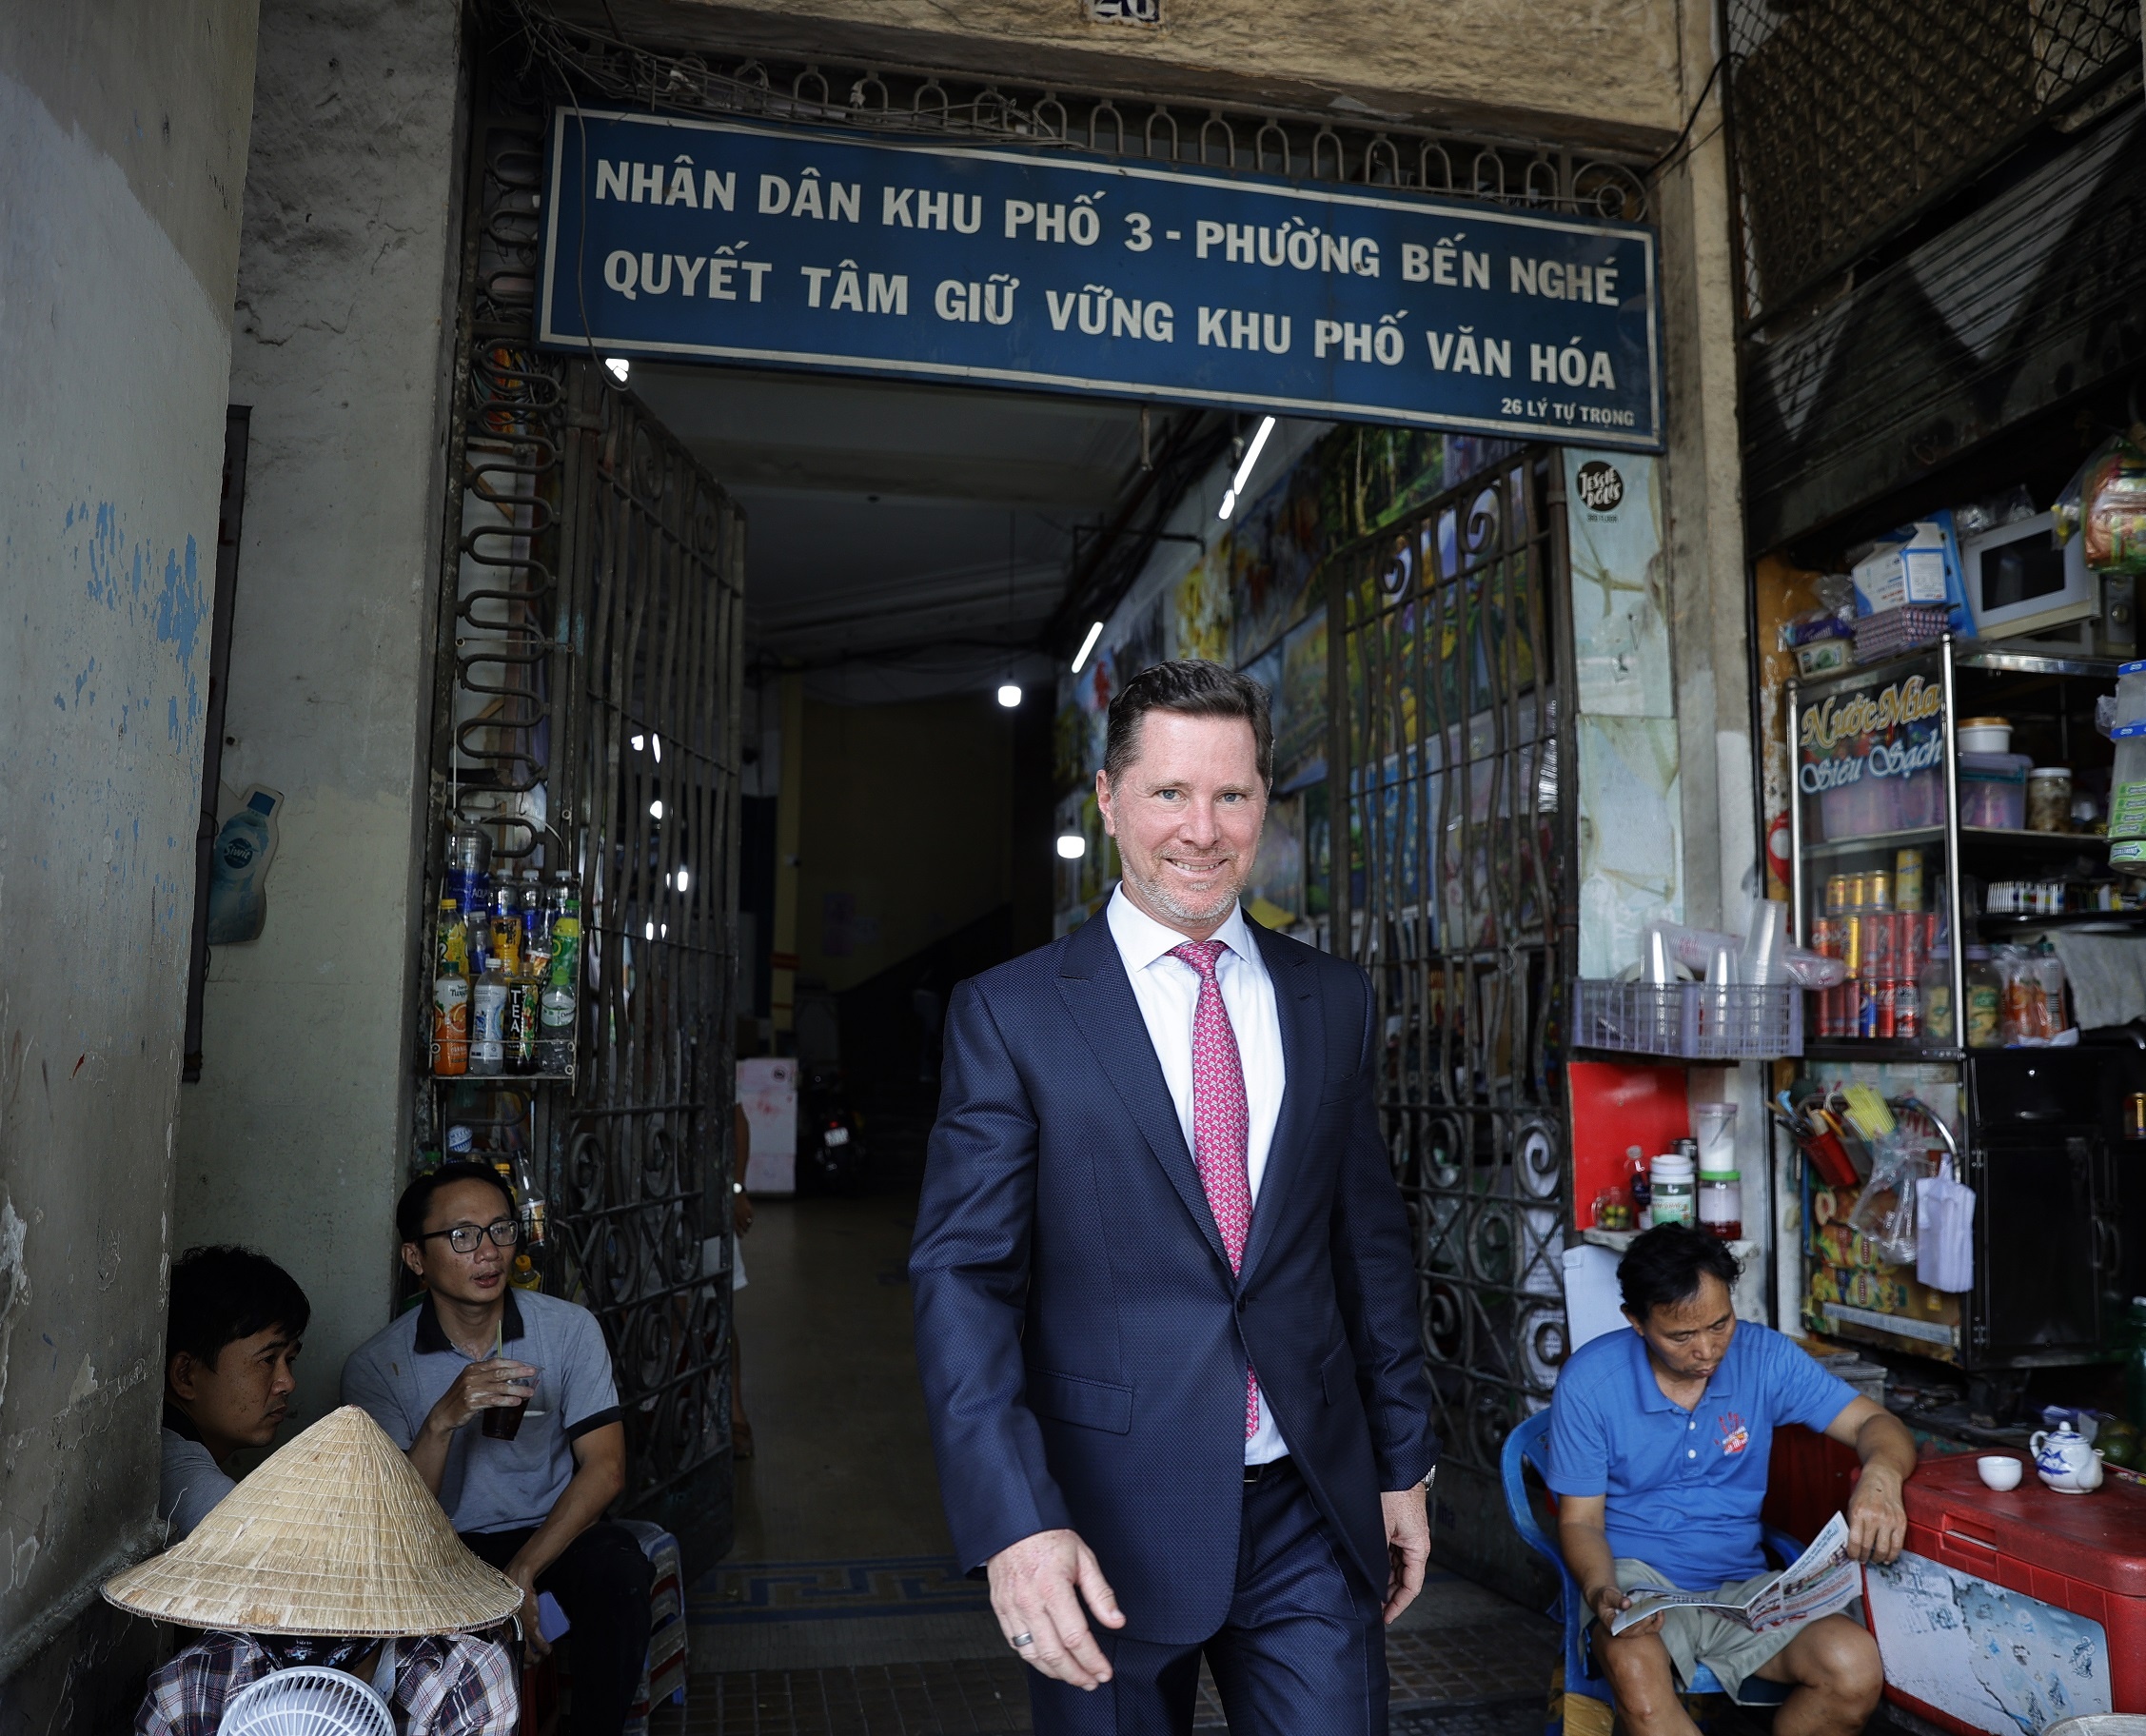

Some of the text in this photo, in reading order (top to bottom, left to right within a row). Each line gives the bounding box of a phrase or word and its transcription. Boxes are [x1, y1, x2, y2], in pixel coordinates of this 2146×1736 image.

[595, 154, 737, 211] NHÂN
[758, 167, 861, 224] DÂN
[882, 187, 982, 234] KHU
[1004, 190, 1108, 247] PHỐ
[1123, 212, 1152, 252] 3
[1195, 215, 1381, 278] PHƯỜNG
[1401, 232, 1490, 290] BẾN
[1509, 256, 1620, 306] NGHÉ
[603, 240, 1616, 390] QUYẾT TÂM GIỮ VỮNG KHU PHỐ VĂN HÓA
[1501, 397, 1635, 428] 26 LÝ TỰ TRỌNG
